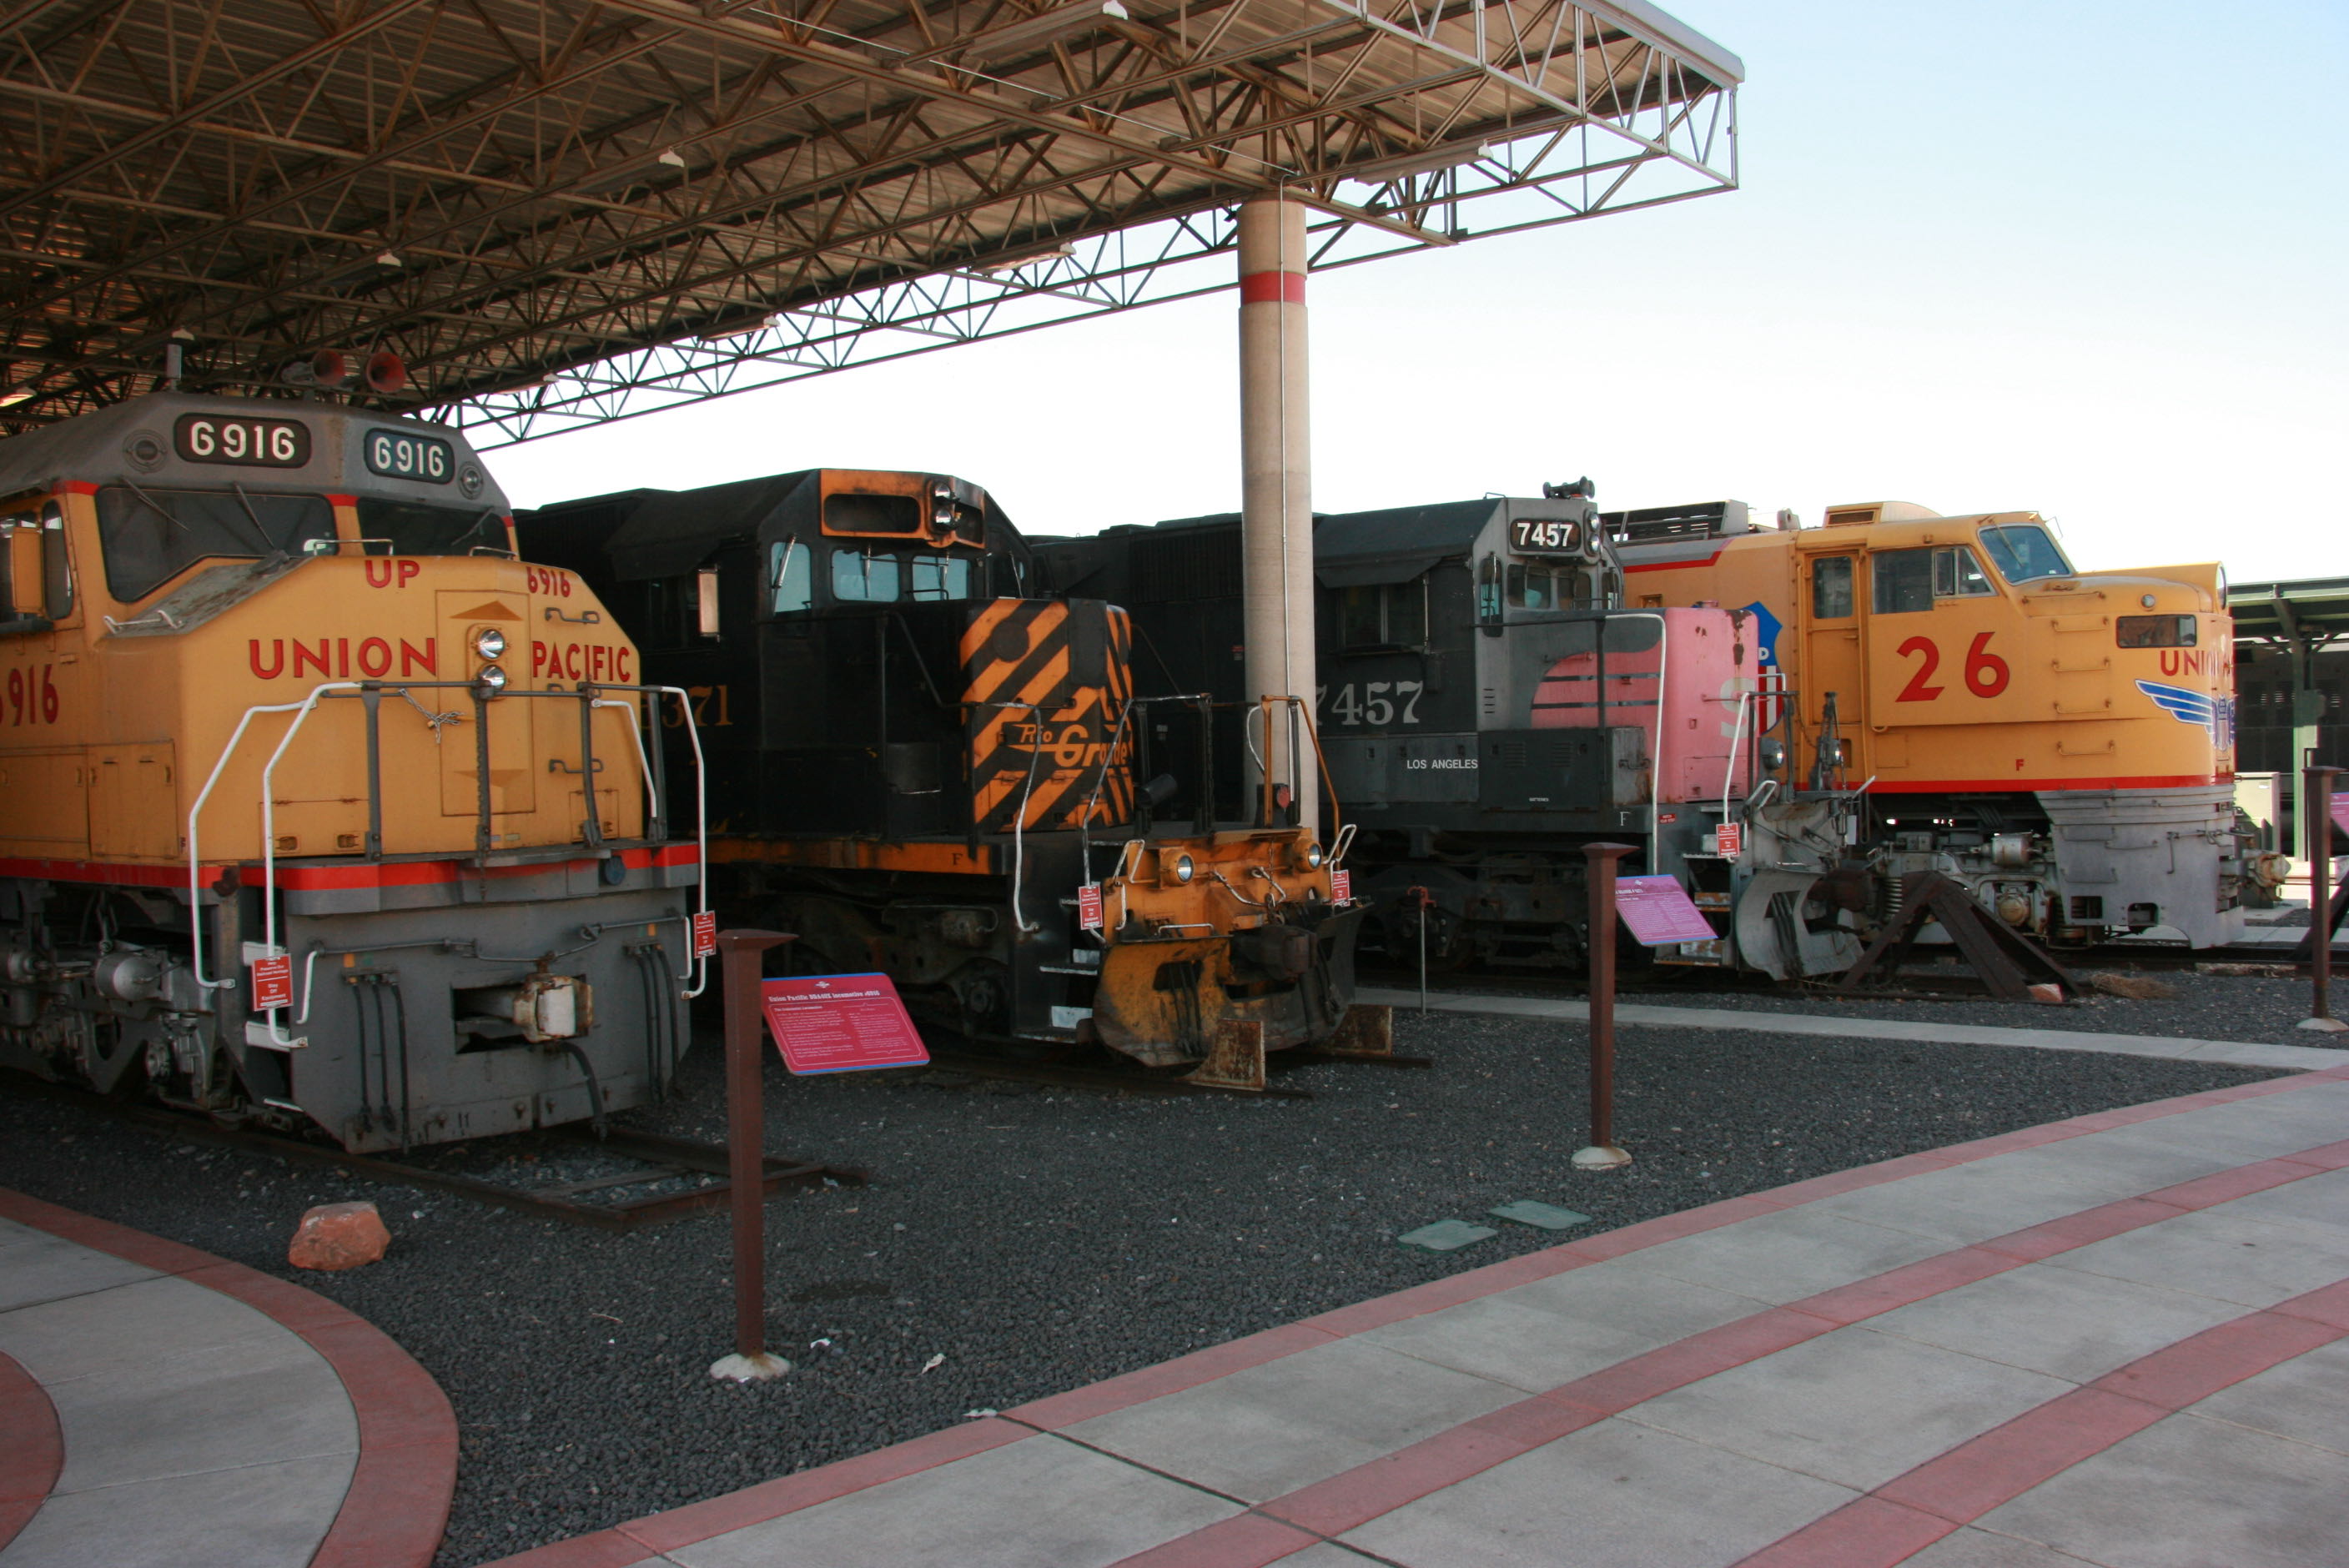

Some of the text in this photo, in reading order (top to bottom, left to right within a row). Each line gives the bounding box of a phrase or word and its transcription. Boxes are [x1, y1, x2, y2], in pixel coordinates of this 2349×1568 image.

[191, 421, 294, 460] 6916
[375, 436, 444, 477] 6916
[1517, 522, 1572, 547] 7457
[365, 560, 420, 588] UP
[526, 566, 571, 597] 6916
[249, 636, 631, 682] UNION PACIFIC
[1895, 631, 2010, 703] 26
[0, 664, 59, 727] 916
[1406, 759, 1478, 769] LOS ANGELES
[2015, 759, 2024, 771] F
[1620, 812, 1630, 826] F
[952, 852, 963, 865] F
